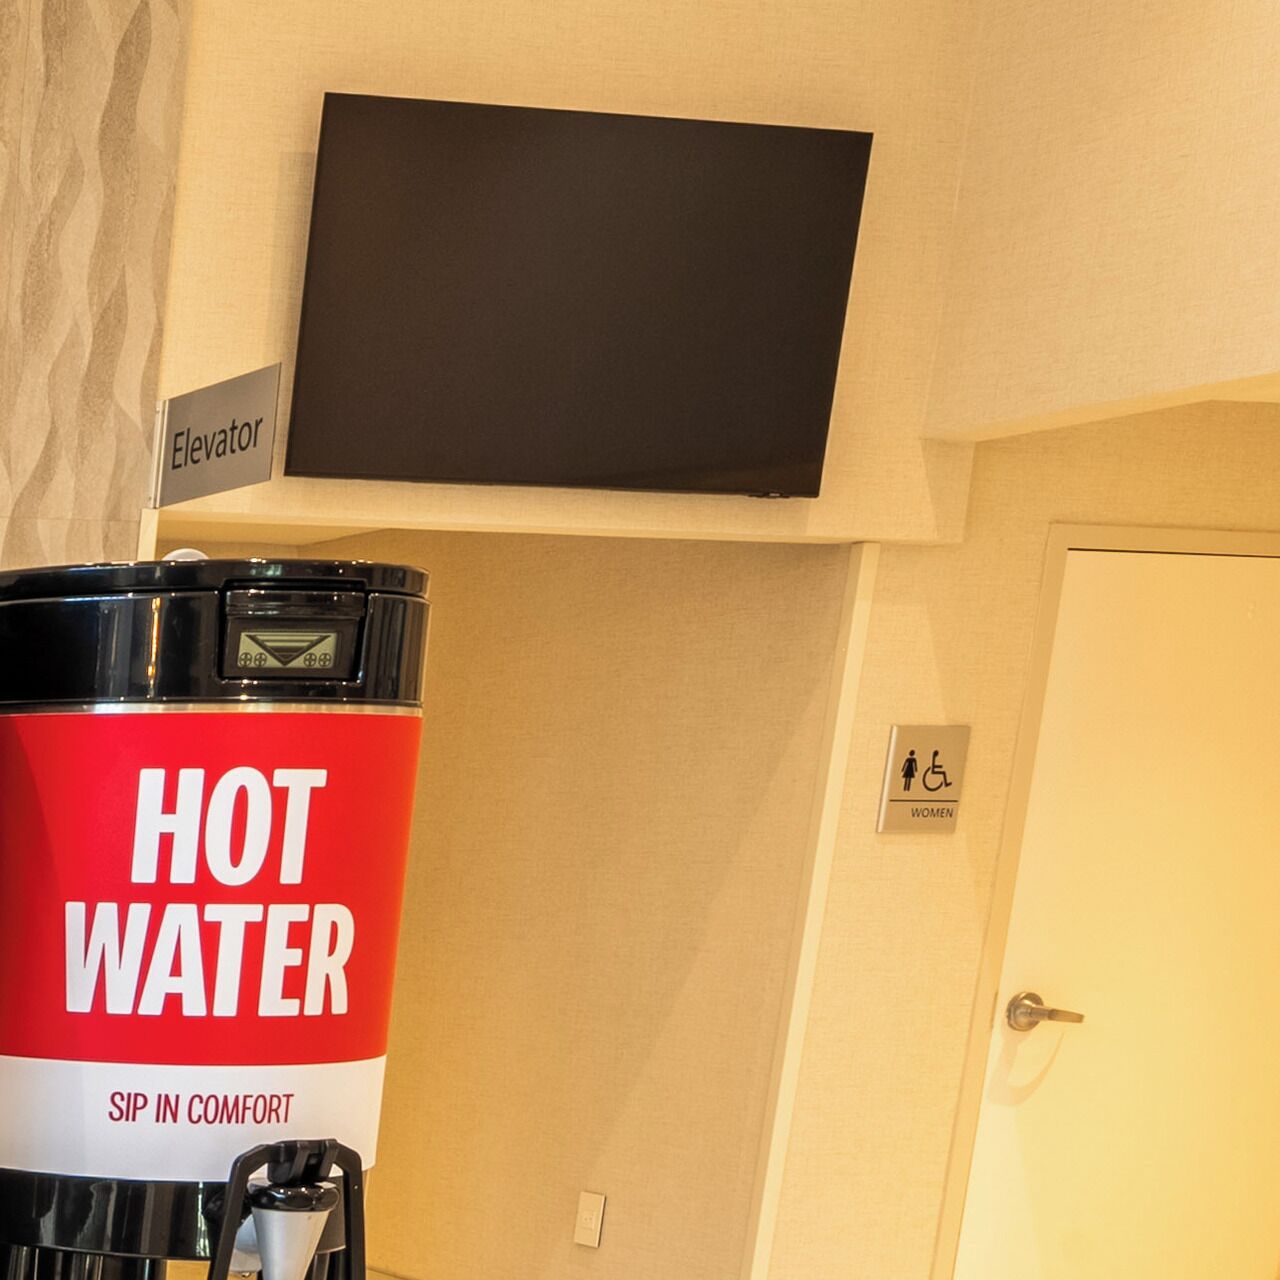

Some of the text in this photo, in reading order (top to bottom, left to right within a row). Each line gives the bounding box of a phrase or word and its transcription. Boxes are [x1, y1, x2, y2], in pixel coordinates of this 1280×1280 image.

[171, 416, 264, 471] Elevator
[131, 766, 328, 886] HOT
[911, 807, 954, 818] WOMEN
[64, 902, 355, 1017] WATER
[108, 1091, 294, 1124] SIP IN COMFORT
